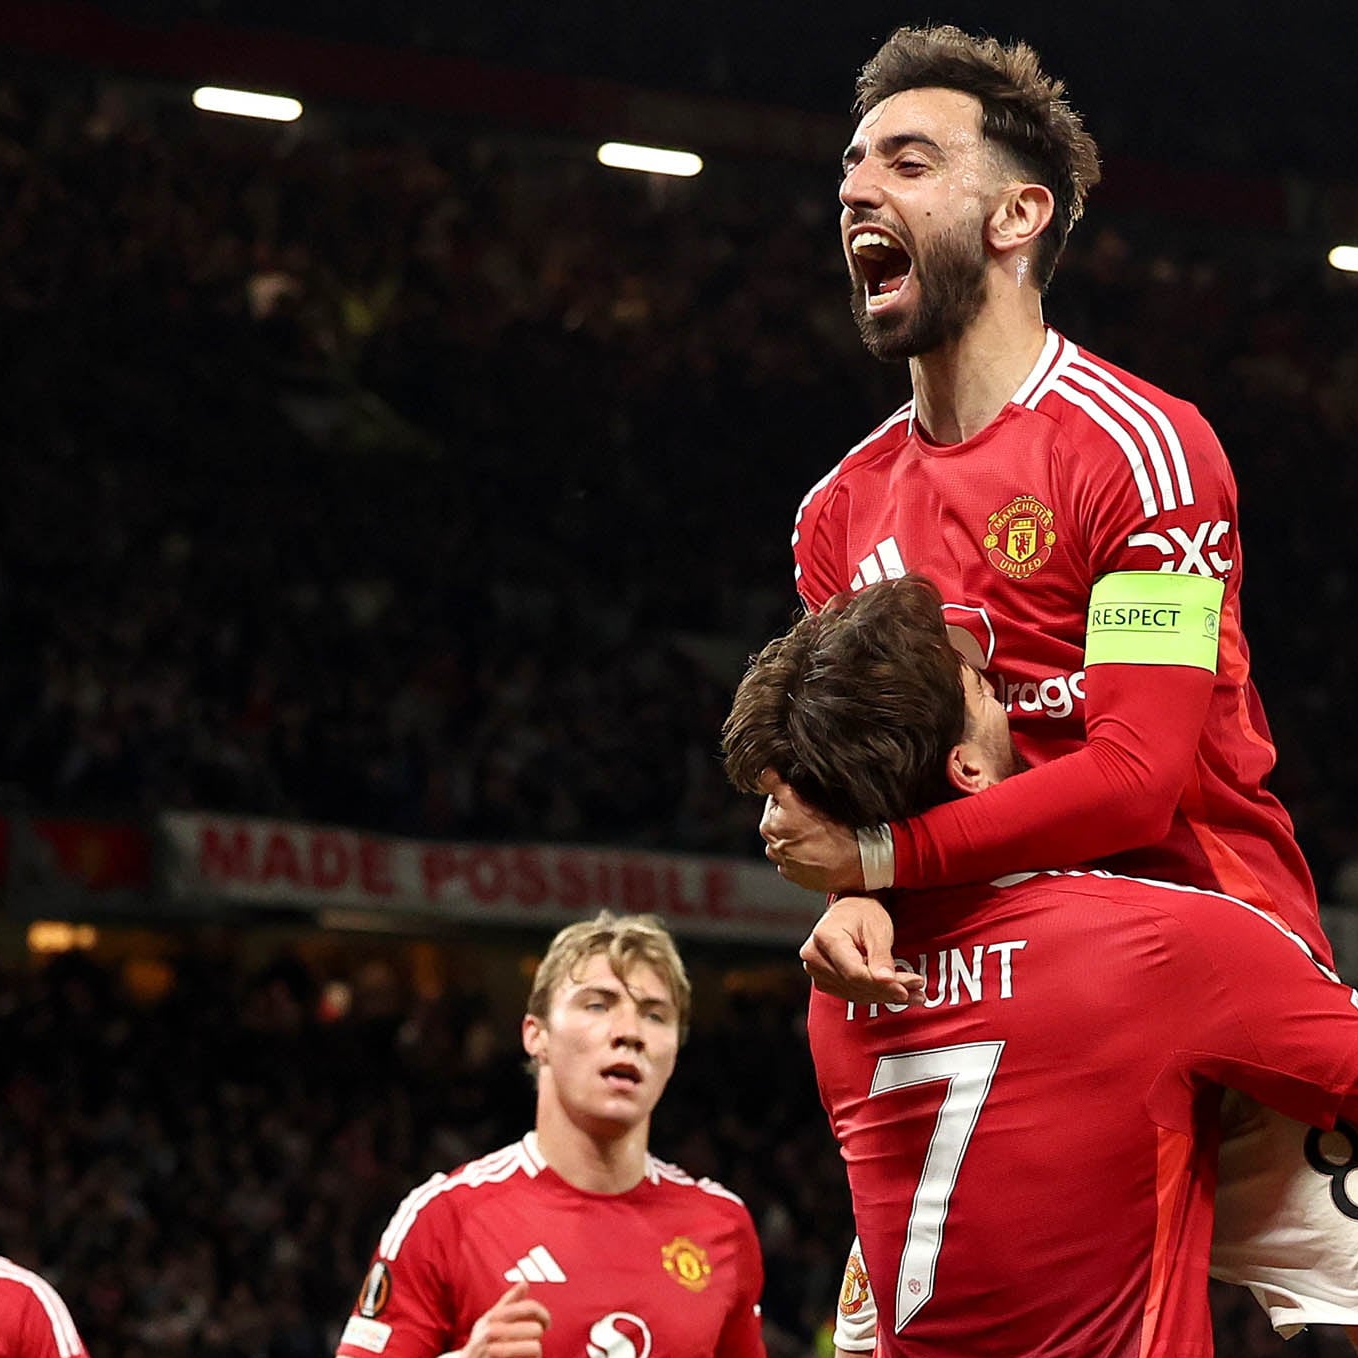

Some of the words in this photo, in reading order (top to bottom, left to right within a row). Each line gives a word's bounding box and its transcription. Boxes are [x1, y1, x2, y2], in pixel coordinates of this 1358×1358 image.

[994, 502, 1050, 529] MANCHESTER
[999, 558, 1042, 573] UNITED
[1092, 608, 1181, 627] RESPECT
[199, 828, 394, 896] MADE
[421, 844, 730, 922] POSSIBLE
[845, 940, 1028, 1021] UNT
[868, 1041, 1006, 1334] 7
